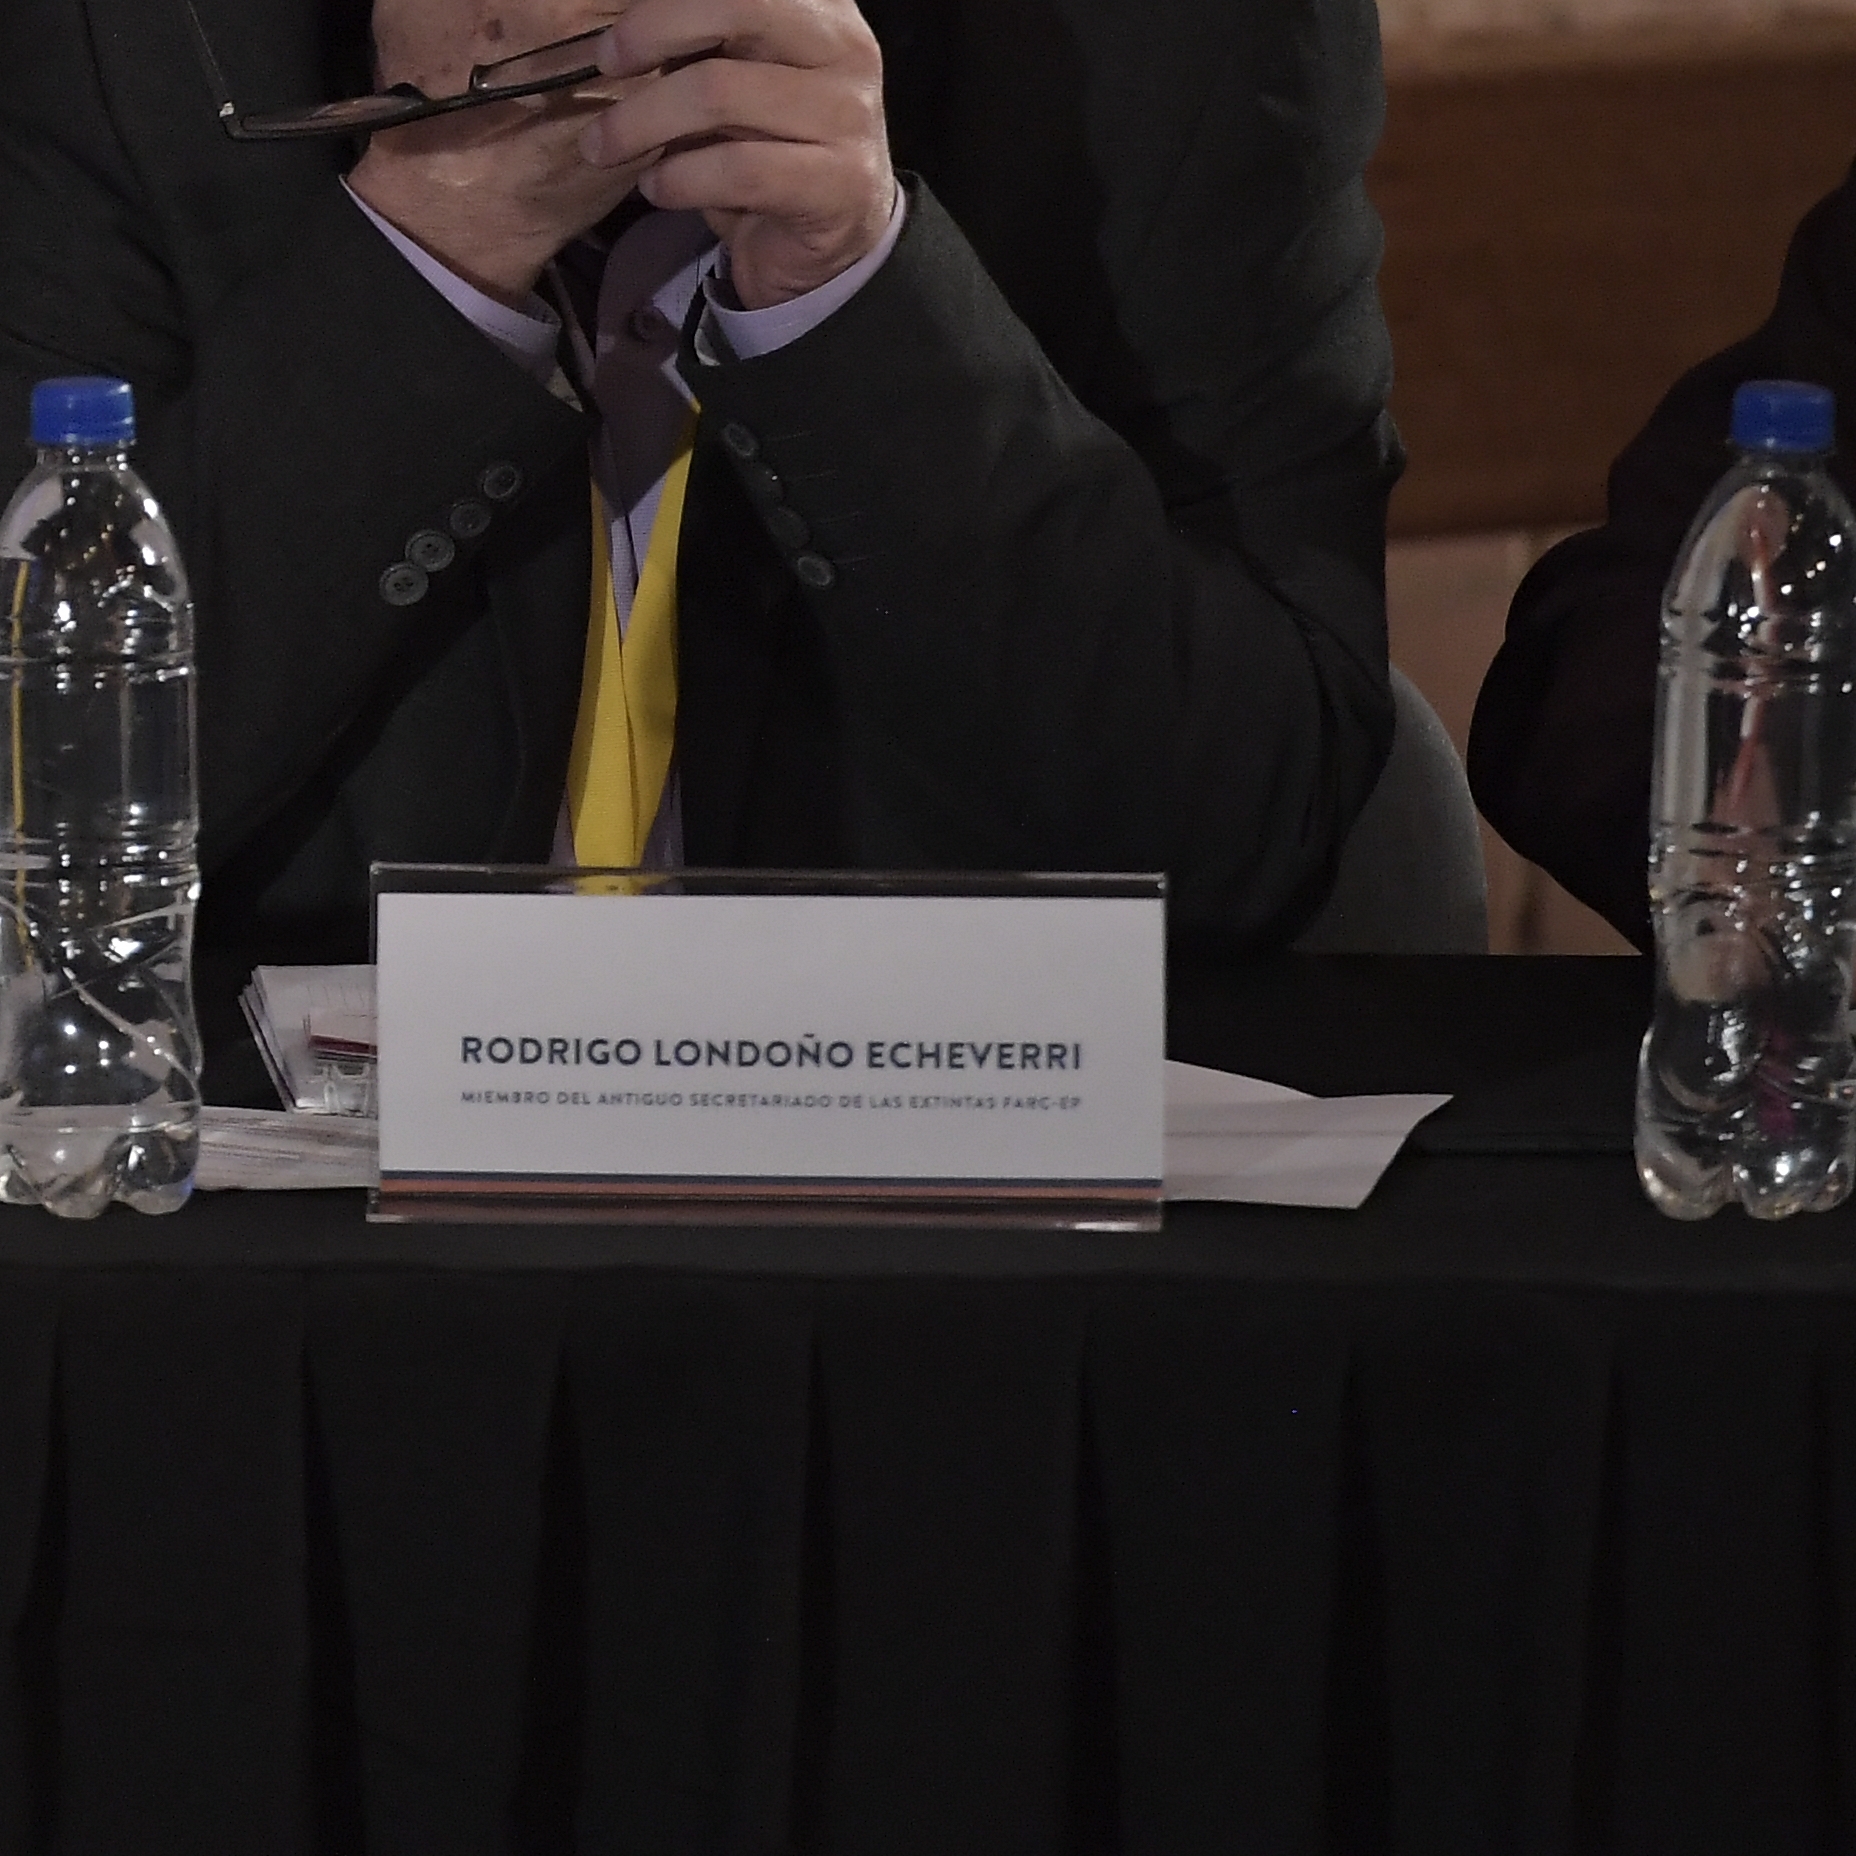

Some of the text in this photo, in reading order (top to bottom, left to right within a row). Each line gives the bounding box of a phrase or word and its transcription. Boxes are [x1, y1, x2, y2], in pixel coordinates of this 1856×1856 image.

[460, 1032, 1082, 1071] RODRIGO LONDOÑO ECHEVERRI
[459, 1089, 1083, 1111] MIEMBRO DEL ANTIGUO SECRETARIADO DE LAS EXTINTAS FARC-EP
